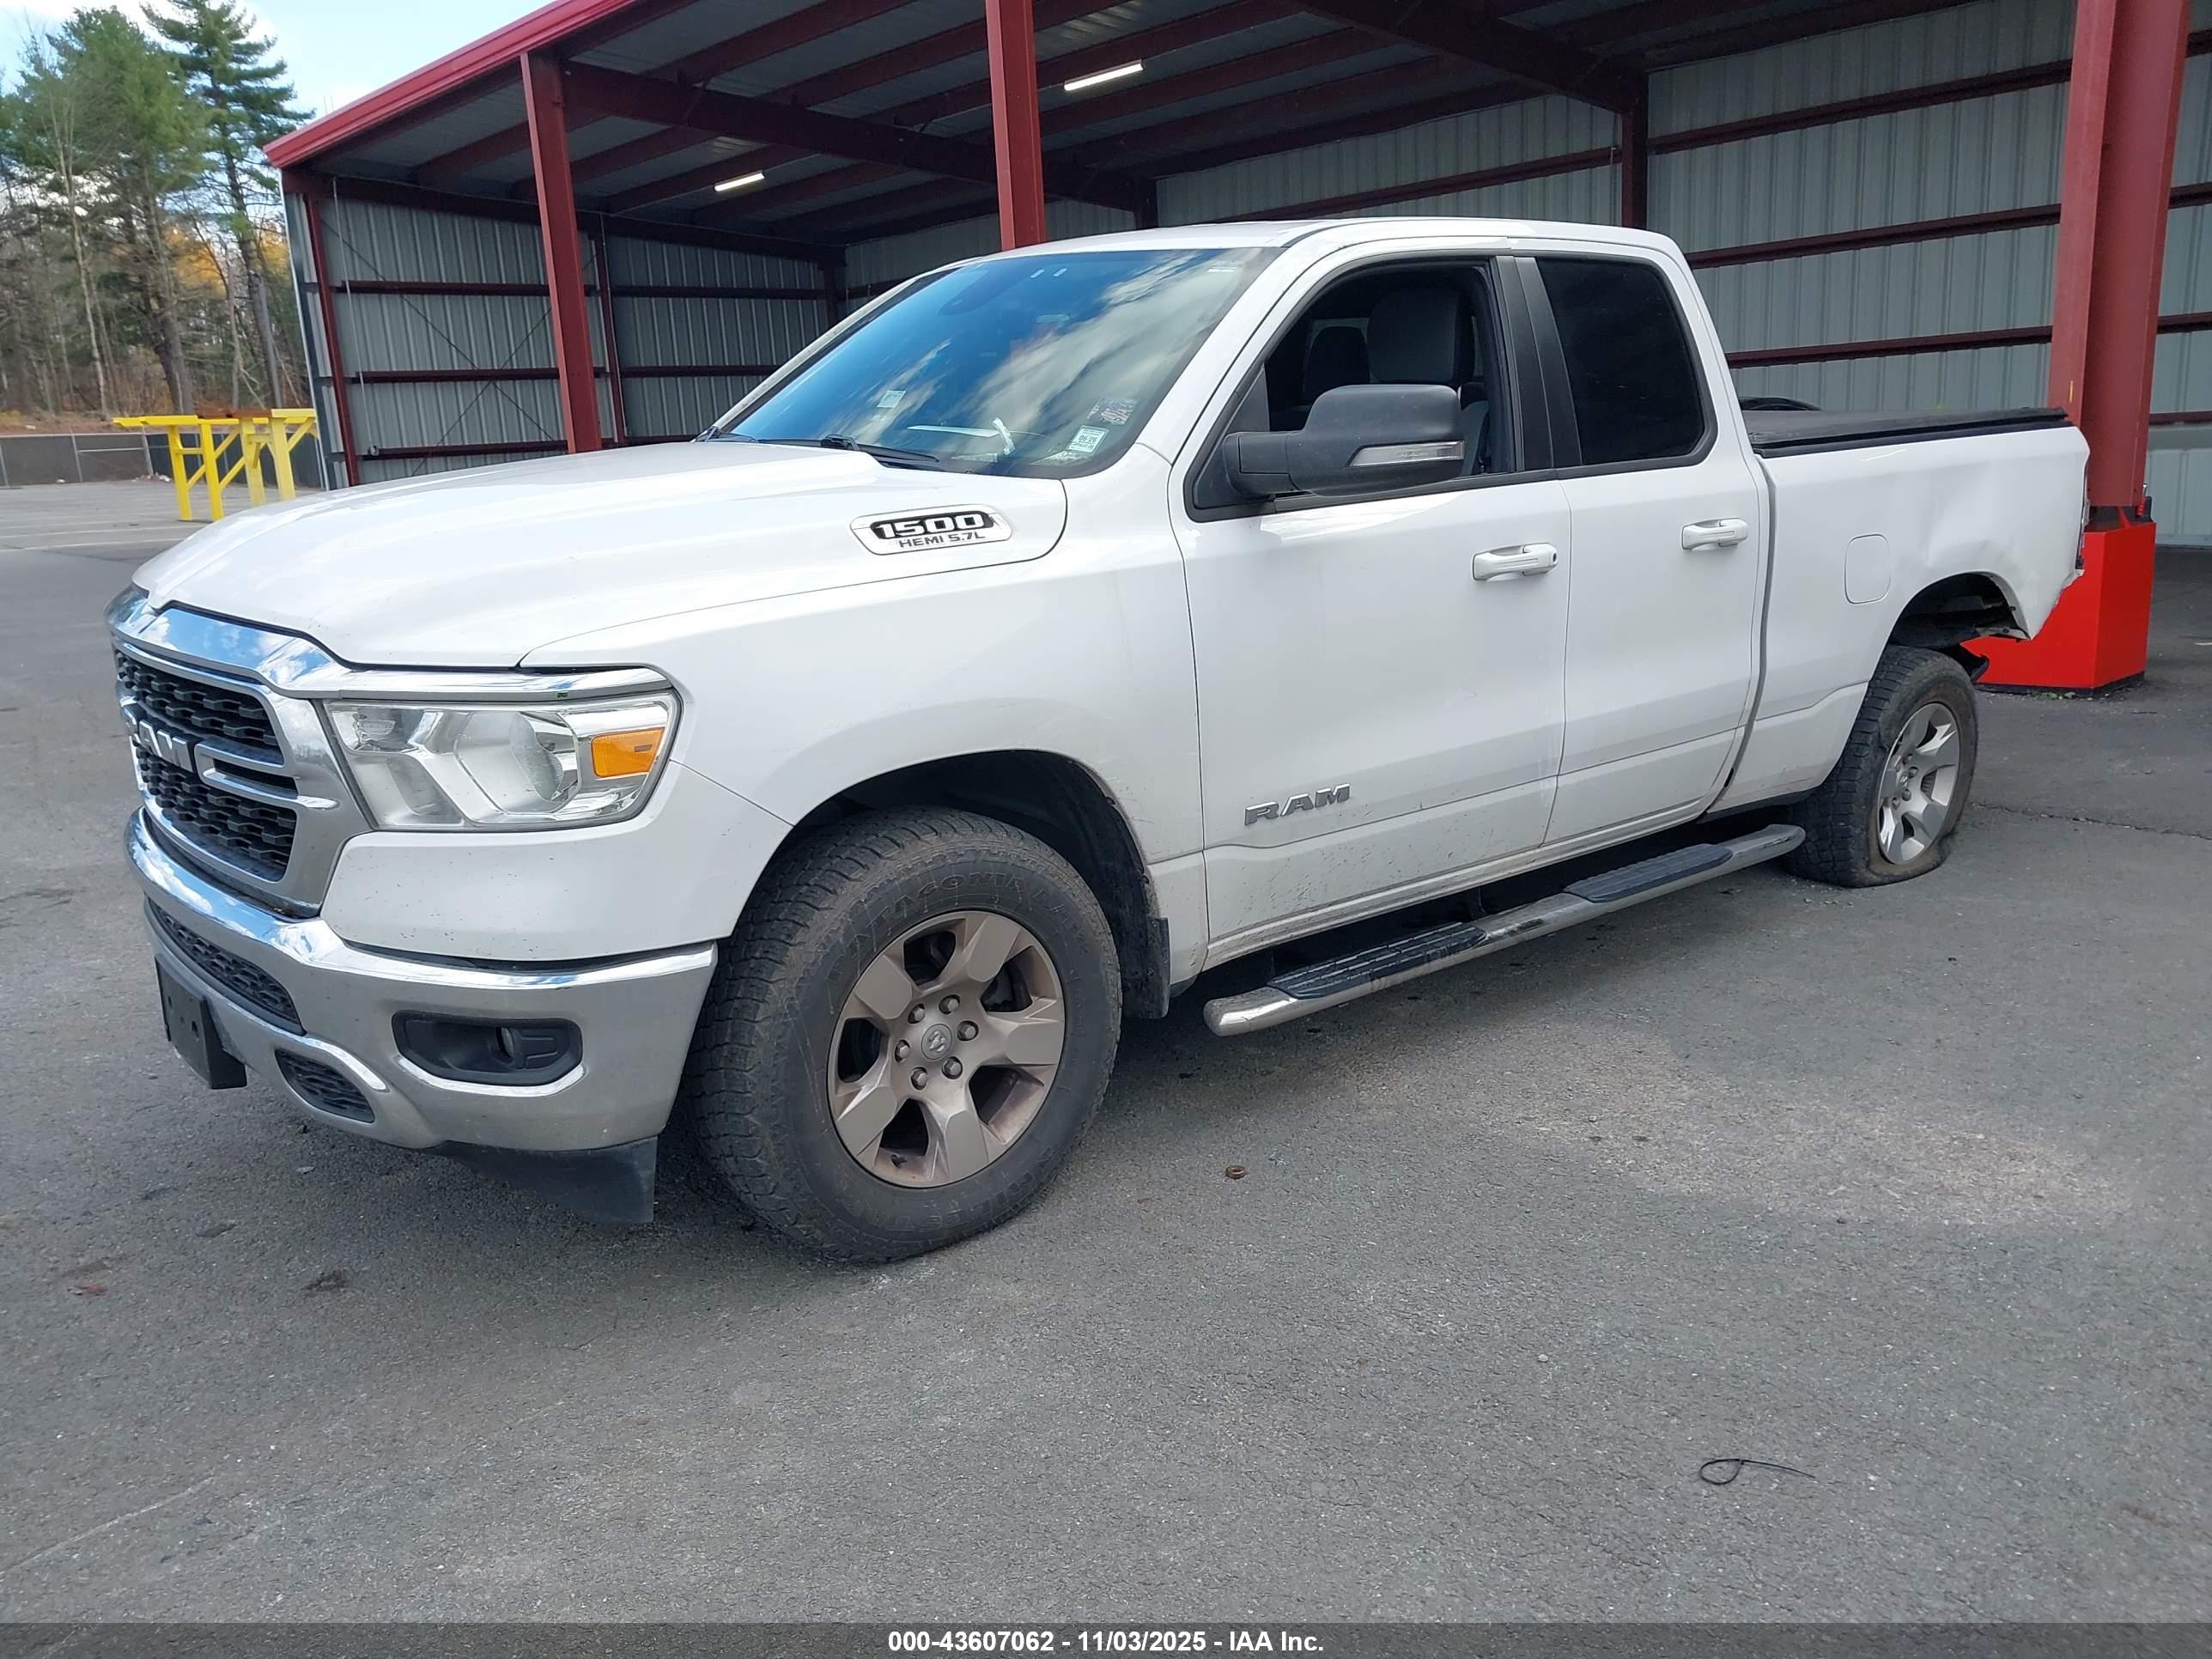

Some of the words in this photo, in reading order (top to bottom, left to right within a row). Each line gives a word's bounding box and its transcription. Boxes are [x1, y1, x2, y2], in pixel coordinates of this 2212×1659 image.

[874, 513, 985, 539] 1500
[899, 535, 945, 548] HEMI
[947, 532, 987, 544] 5.7L
[1244, 782, 1351, 826] RAM
